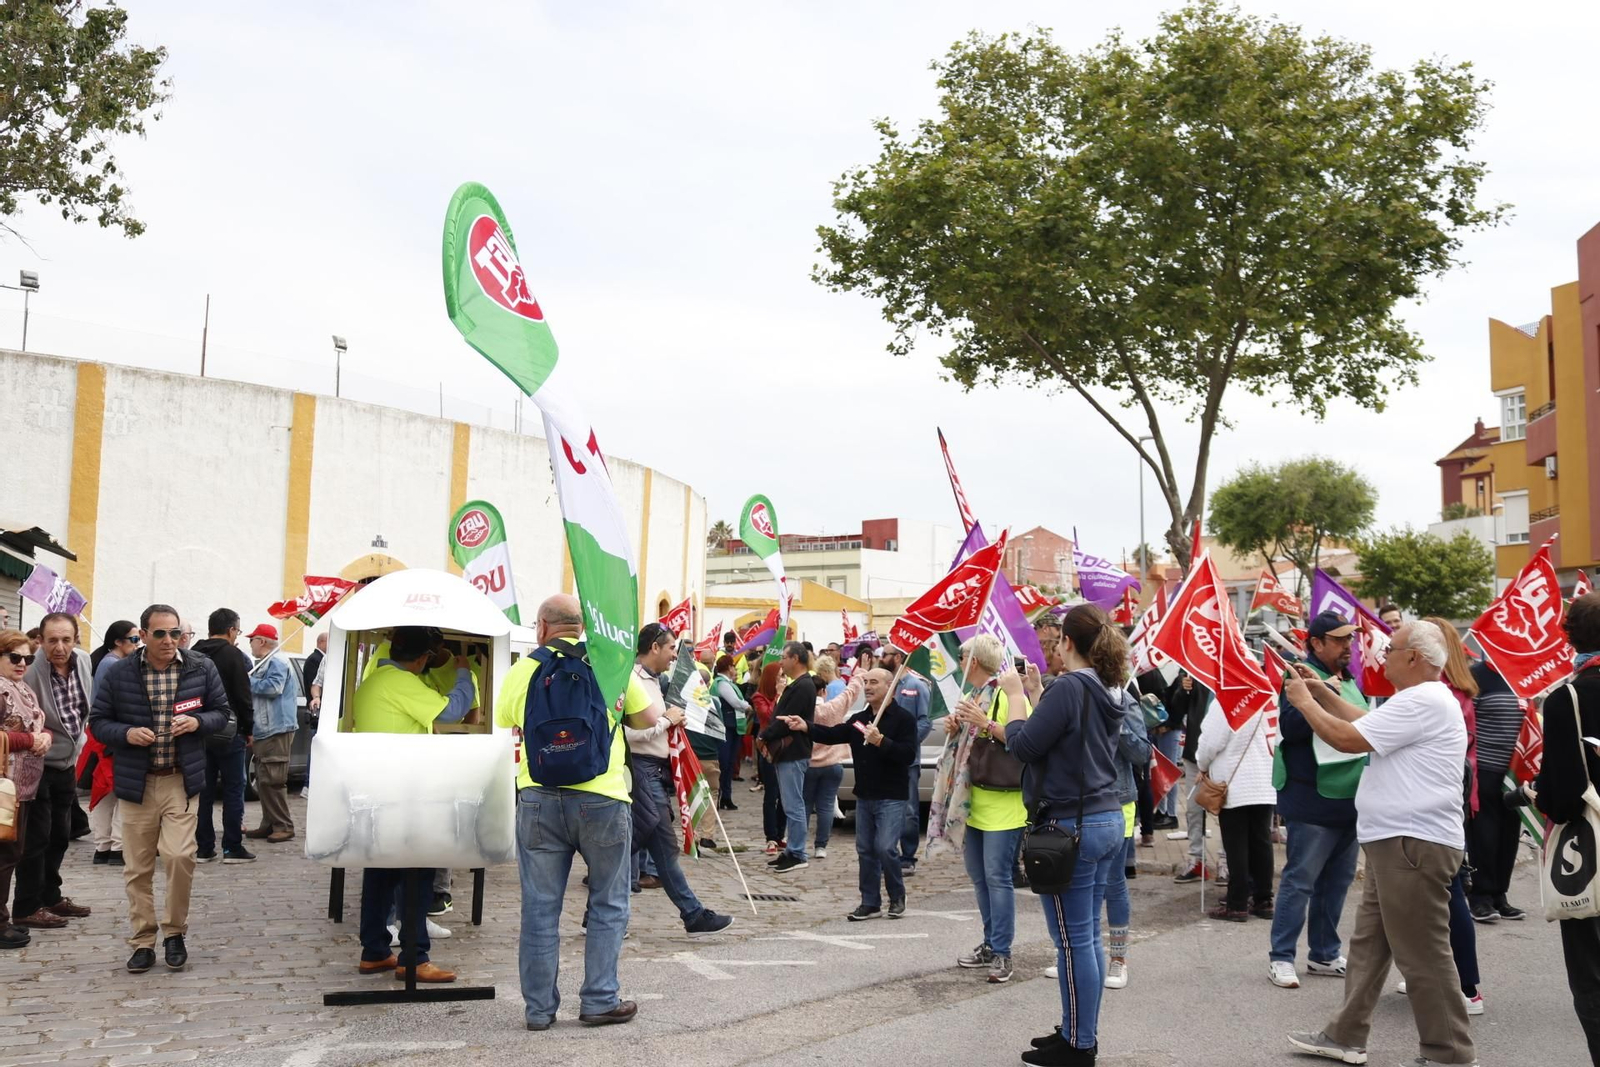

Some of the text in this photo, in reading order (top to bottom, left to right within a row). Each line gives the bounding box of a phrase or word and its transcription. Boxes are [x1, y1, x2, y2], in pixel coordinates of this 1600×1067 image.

[406, 593, 441, 604] UGT
[176, 700, 197, 711] CCOO
[1561, 836, 1583, 876] S
[1570, 897, 1591, 908] SALTO
